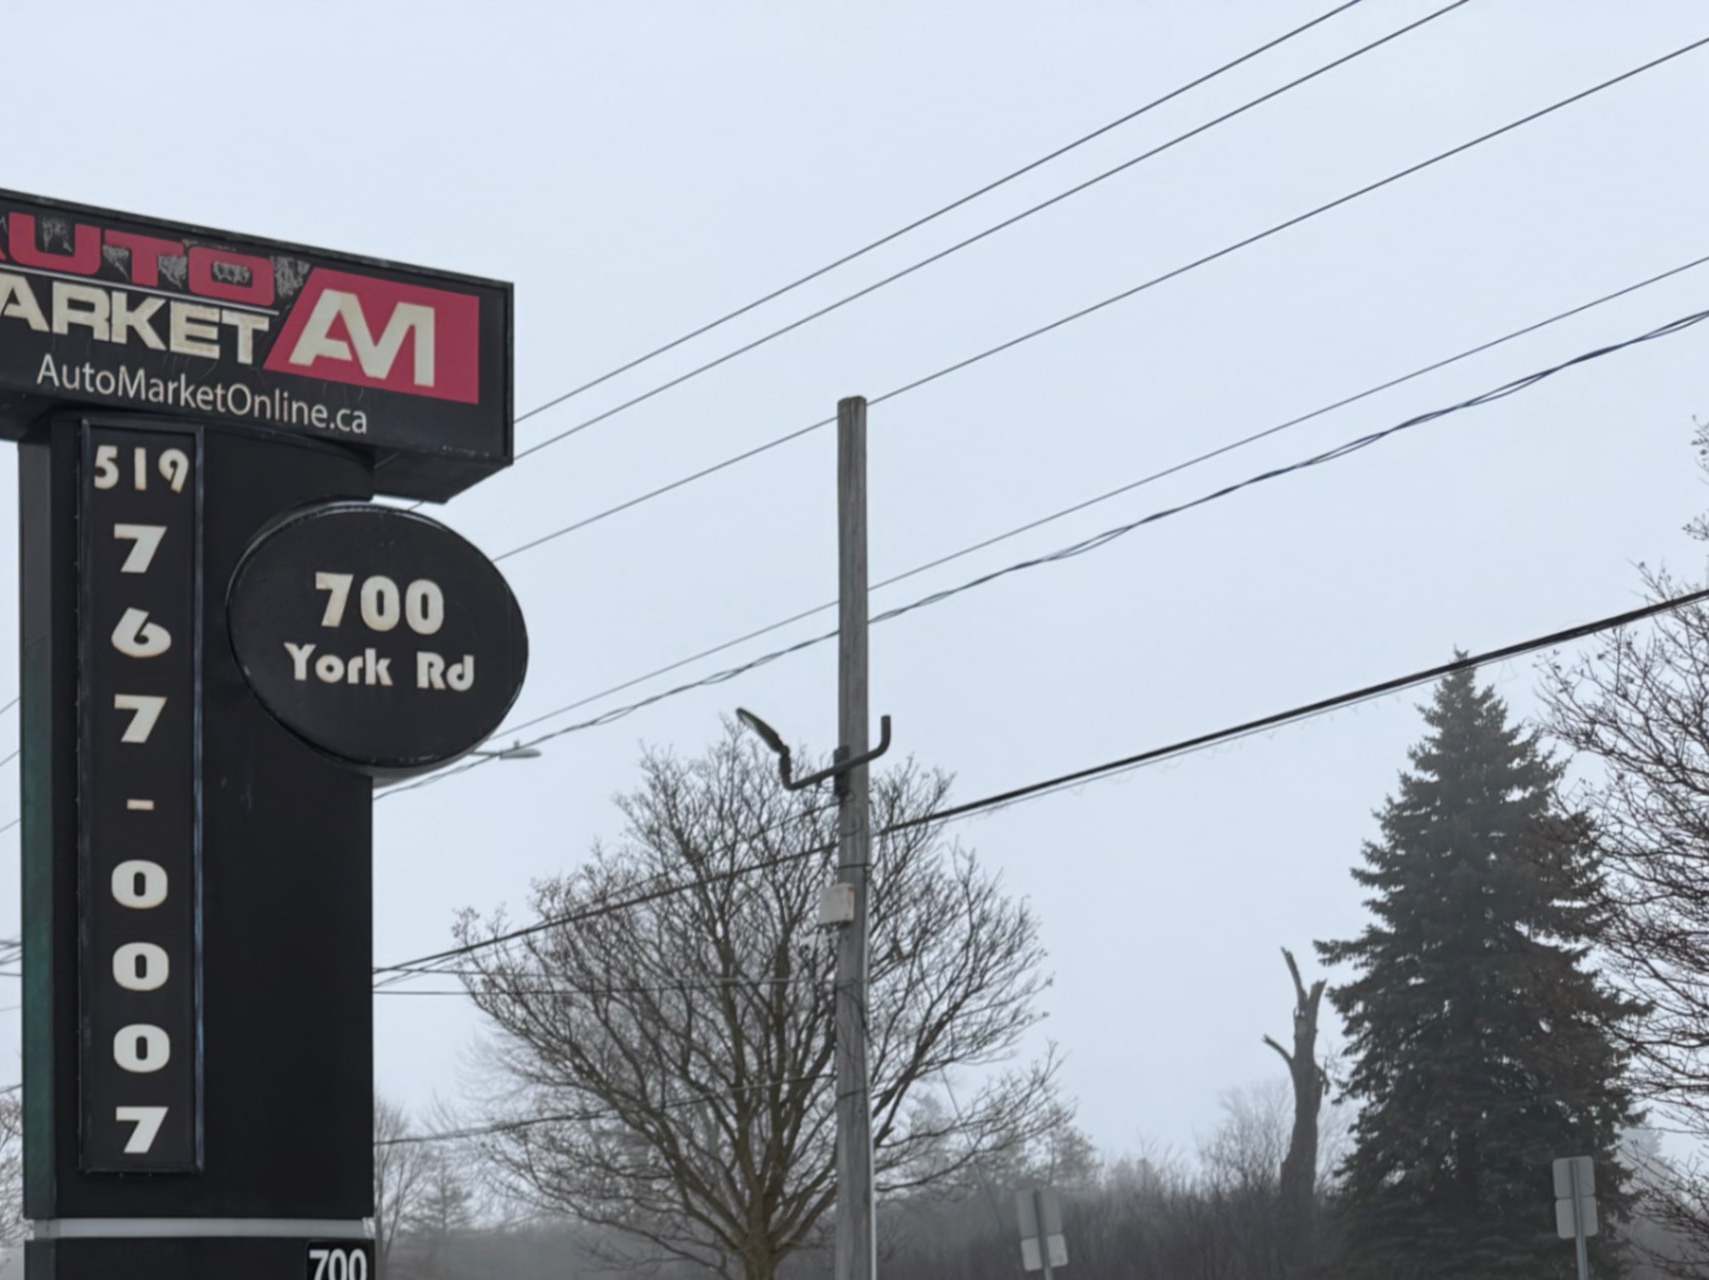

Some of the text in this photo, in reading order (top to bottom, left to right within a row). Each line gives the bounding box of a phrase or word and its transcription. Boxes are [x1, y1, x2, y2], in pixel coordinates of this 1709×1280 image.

[288, 288, 435, 387] AM
[36, 353, 368, 434] AutoMarketOnline.ca
[94, 445, 190, 493] 519
[314, 570, 445, 635] 700
[283, 642, 475, 692] York Rd
